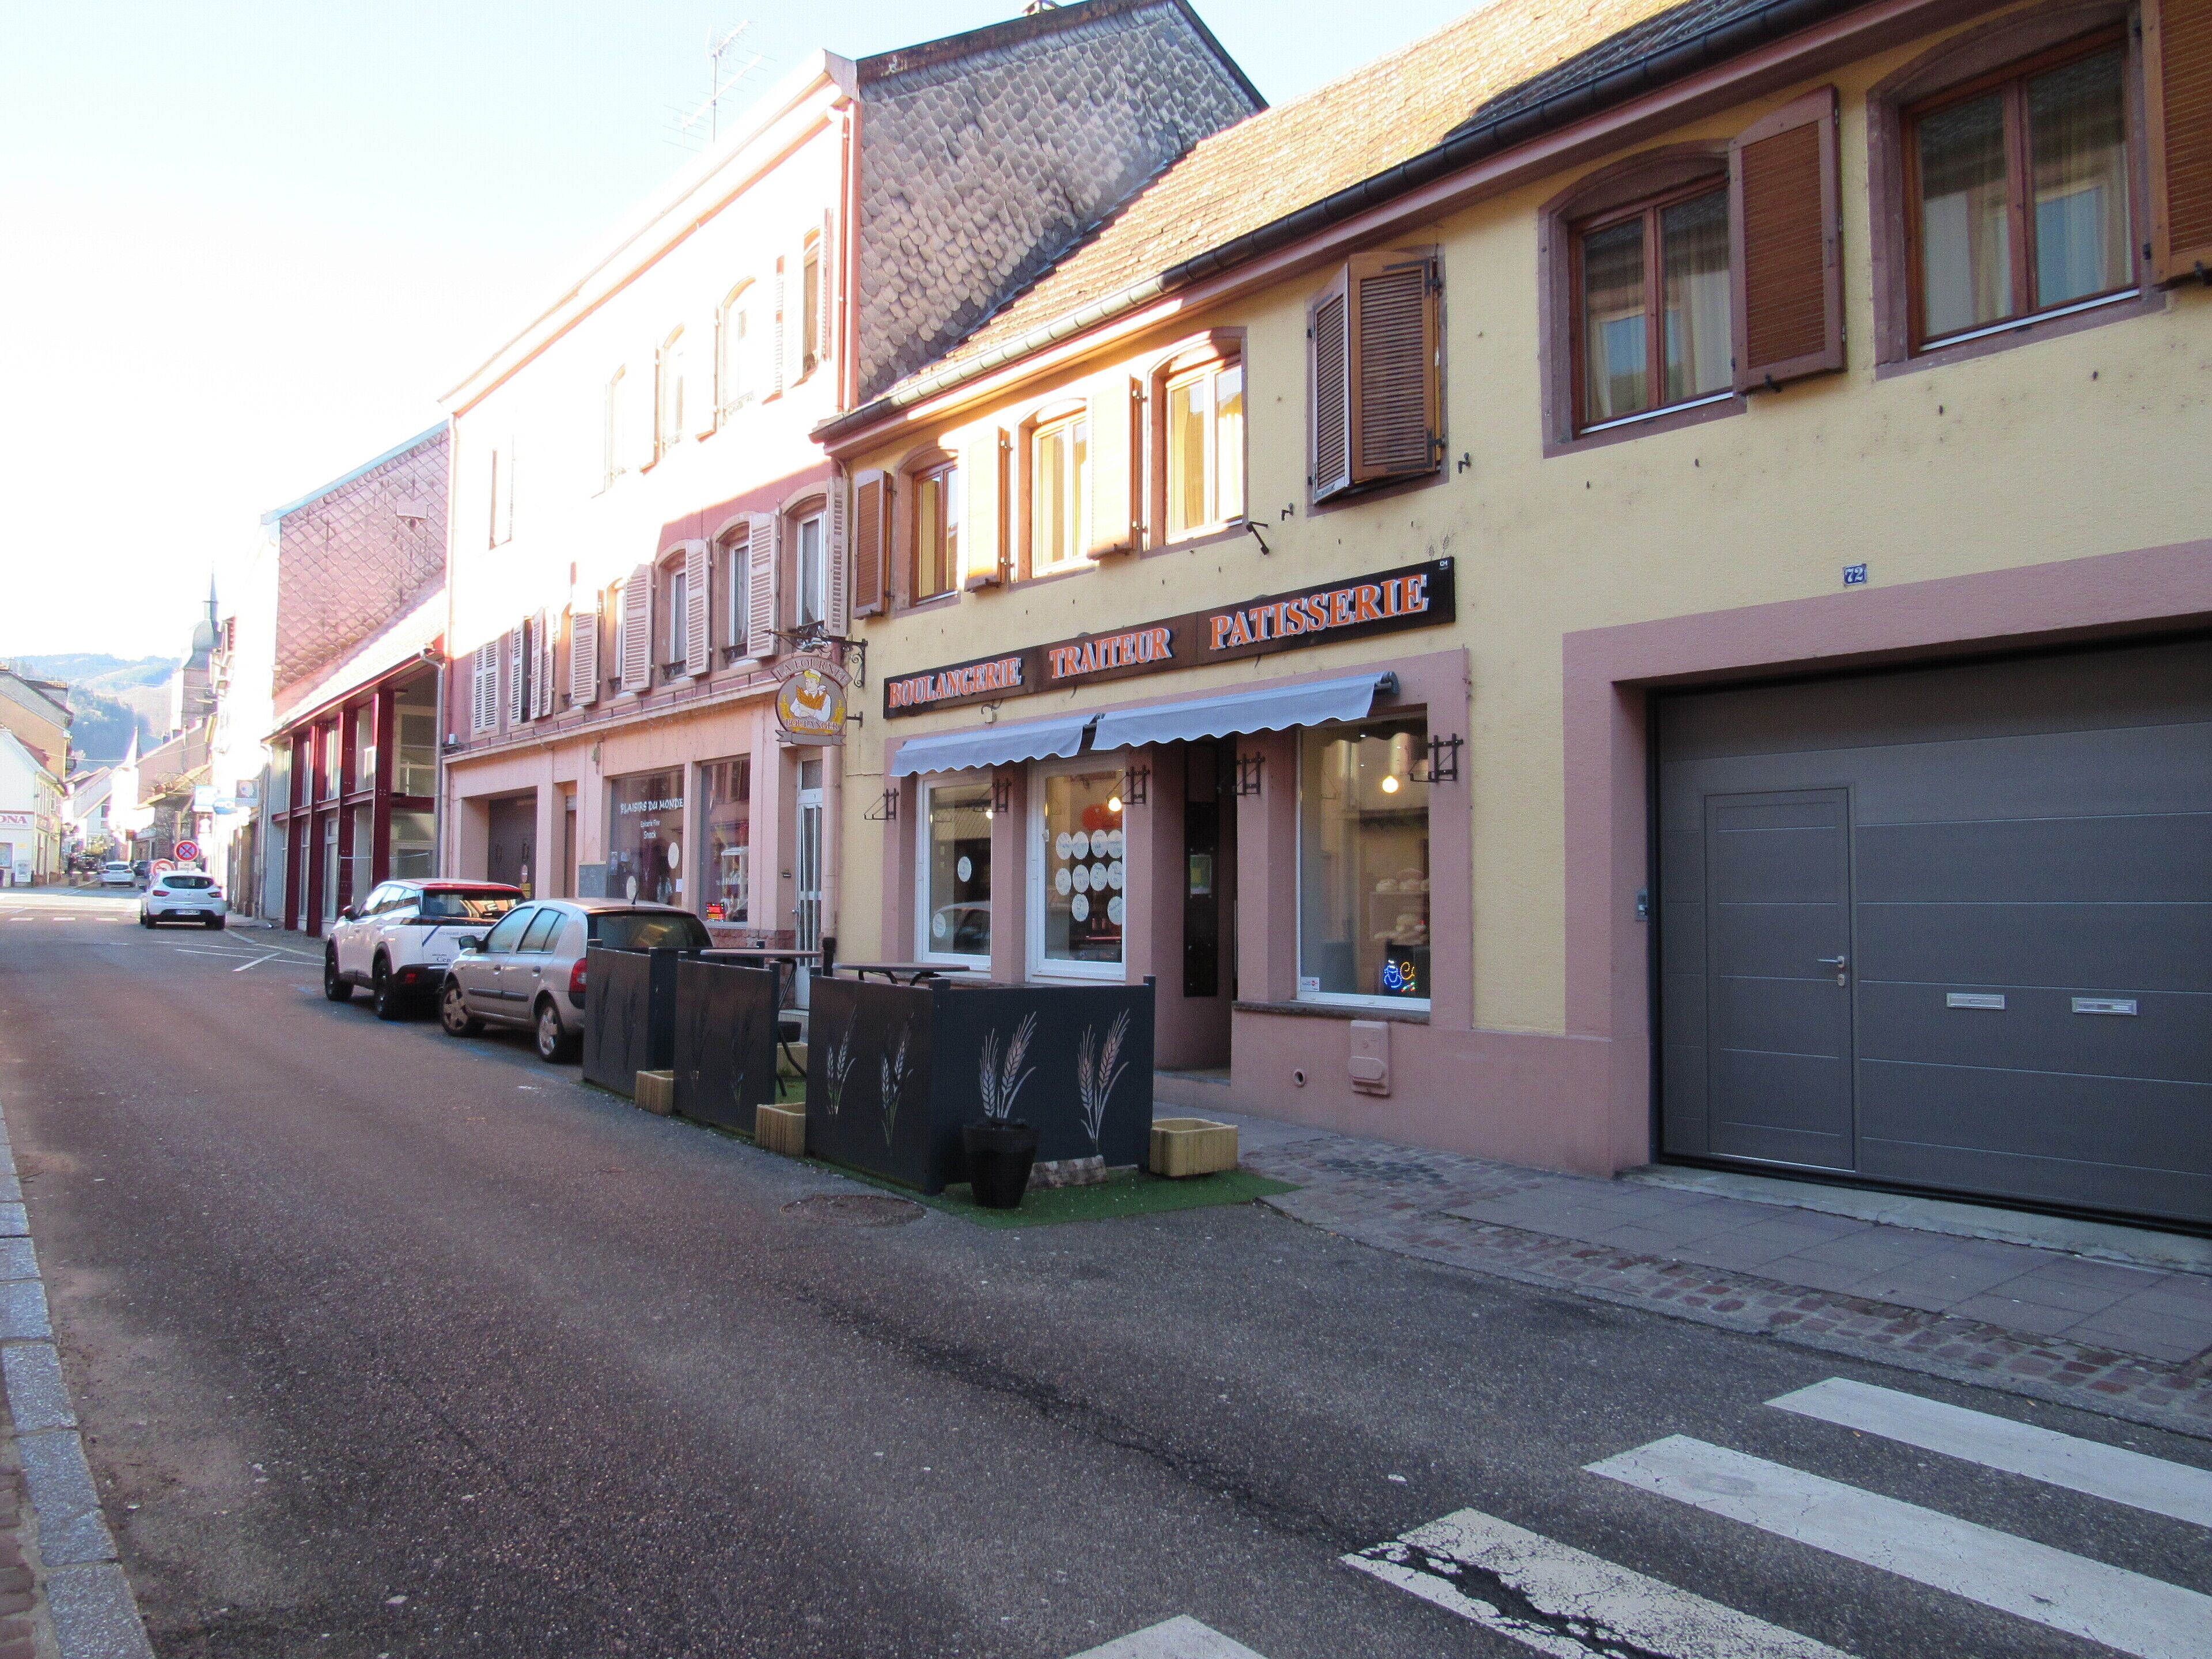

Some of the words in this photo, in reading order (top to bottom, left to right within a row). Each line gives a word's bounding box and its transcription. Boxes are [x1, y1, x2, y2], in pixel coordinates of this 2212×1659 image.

[1845, 567, 1863, 582] 72
[889, 657, 1021, 708] BOULANGERIE
[1049, 627, 1172, 679] TRAITEUR
[1210, 574, 1429, 650] PATISSERIE
[775, 665, 793, 679] LA
[786, 719, 838, 729] BOULANGER
[620, 801, 647, 815] PLAISIRS
[648, 800, 658, 811] DU
[659, 798, 683, 810] MONDE
[643, 830, 657, 839] Snack
